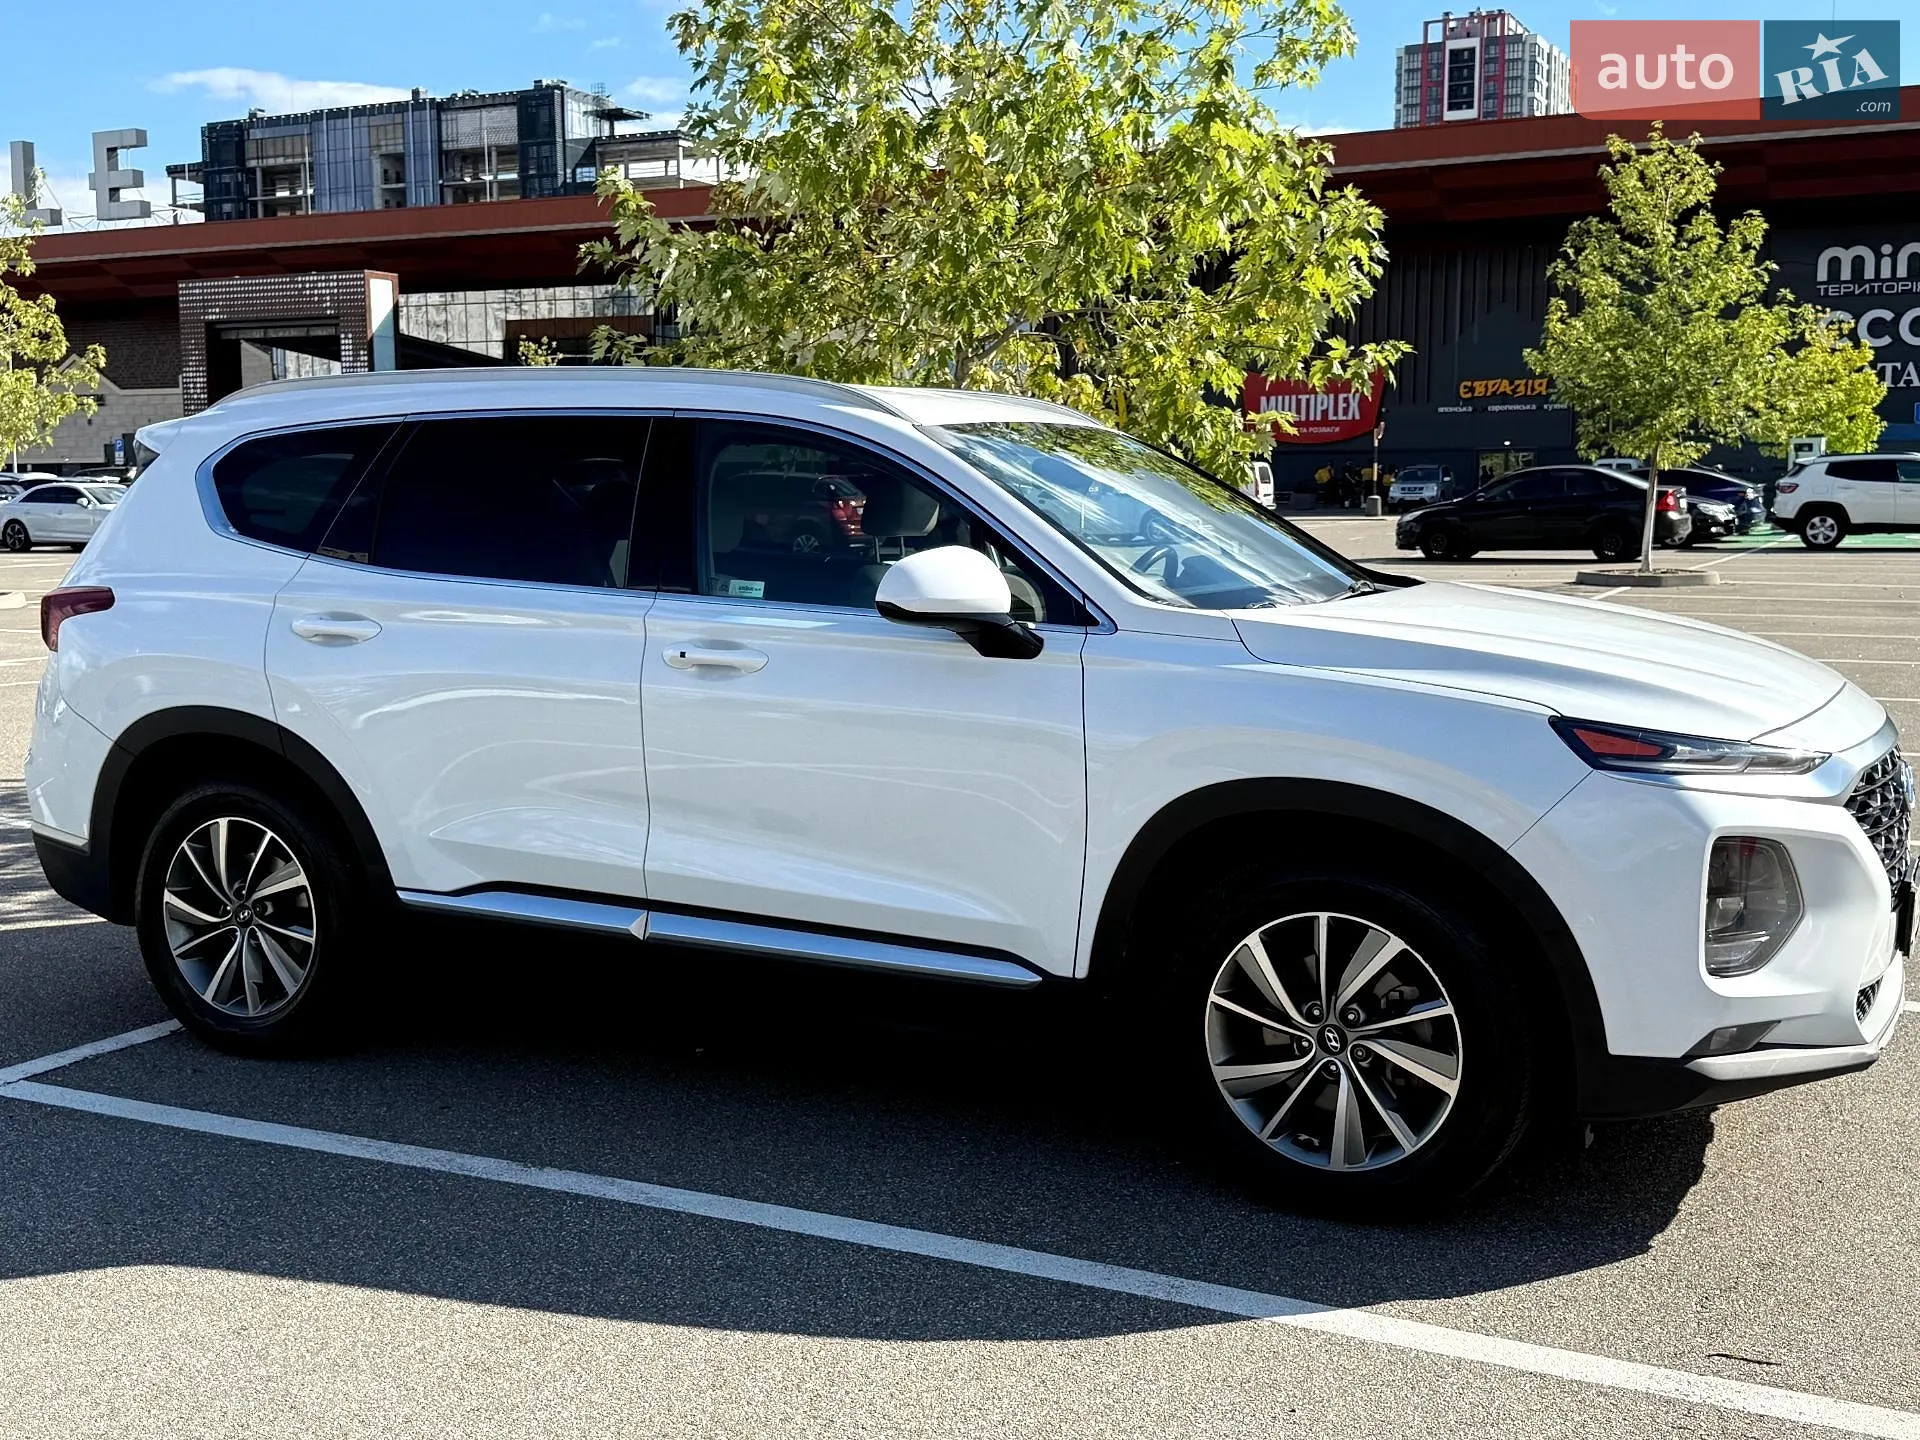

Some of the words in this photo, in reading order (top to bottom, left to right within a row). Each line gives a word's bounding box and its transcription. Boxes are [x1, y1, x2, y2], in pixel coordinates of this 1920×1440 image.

[1816, 281, 1920, 297] ТЕРИТОРІ
[1459, 378, 1549, 399] ЄВРАЗІЯ
[1259, 392, 1361, 422] MULTIPLEX
